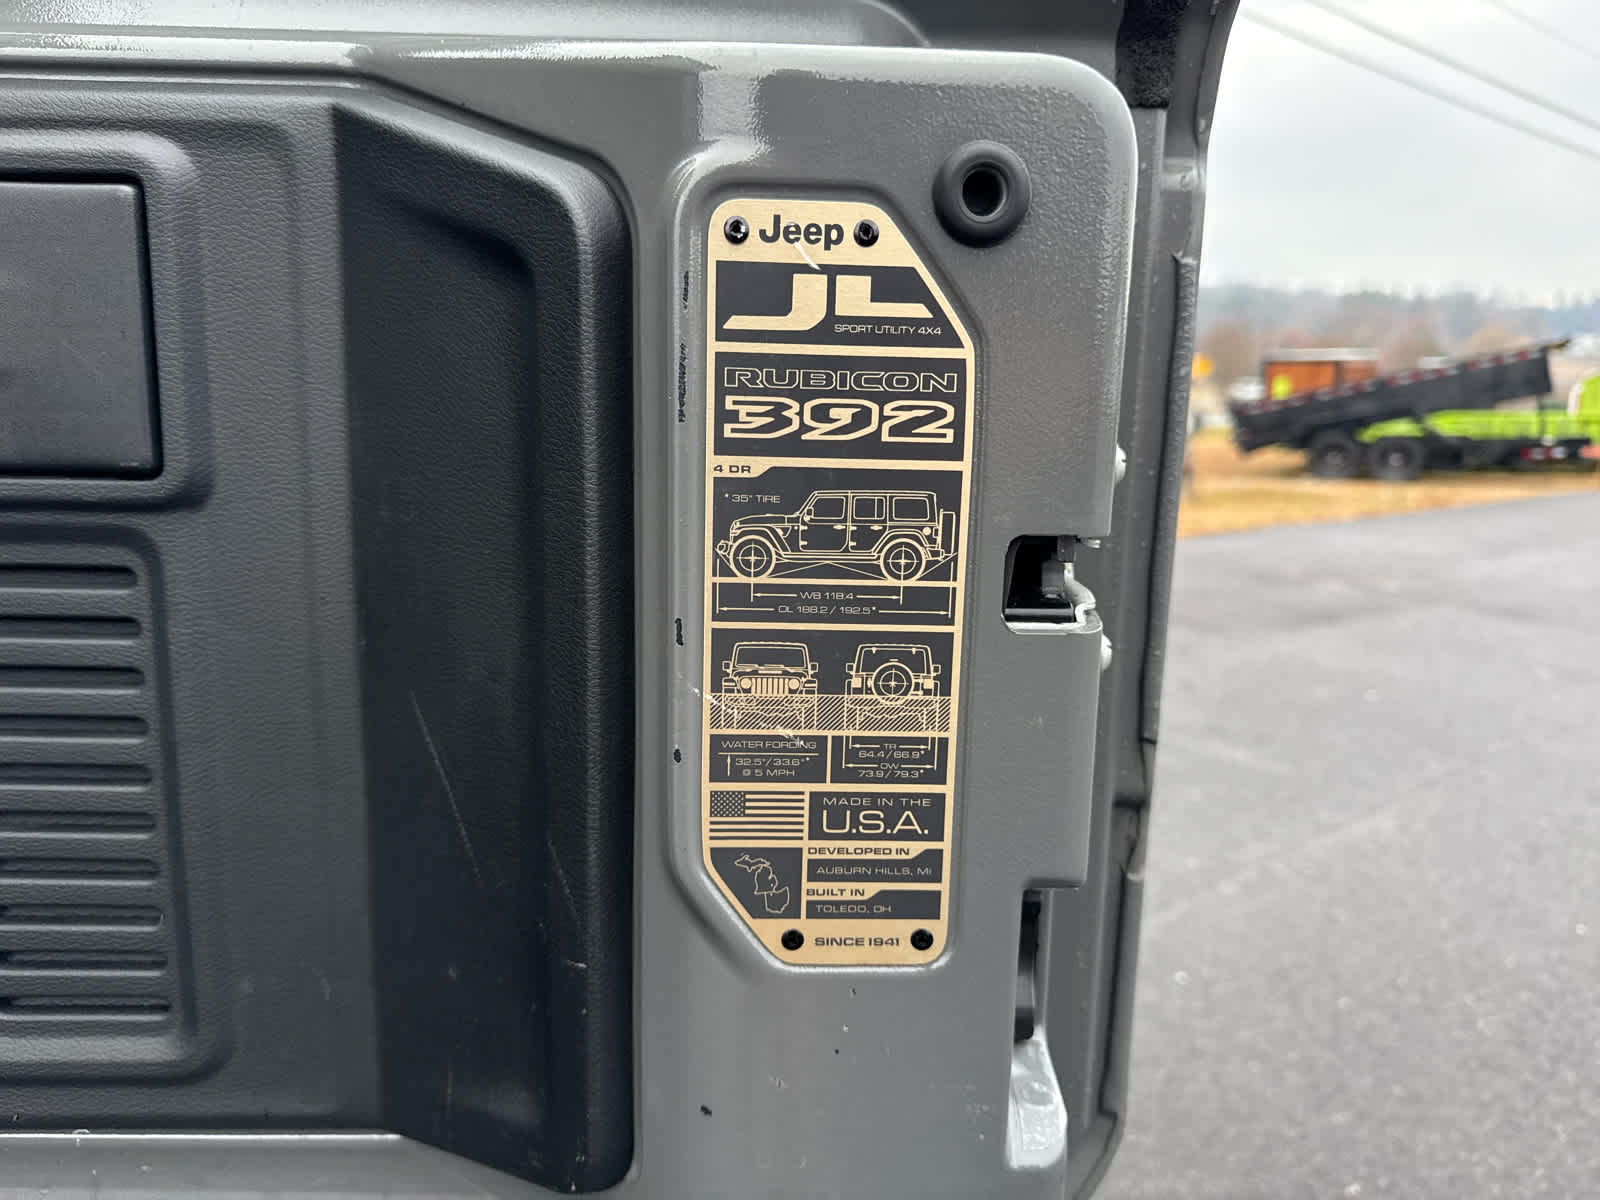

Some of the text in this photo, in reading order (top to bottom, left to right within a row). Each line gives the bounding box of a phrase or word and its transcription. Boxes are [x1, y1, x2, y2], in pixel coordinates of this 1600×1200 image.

[758, 214, 844, 251] Jeep
[722, 273, 934, 331] JL
[834, 323, 873, 334] SPORT
[875, 324, 915, 335] UTILITY
[724, 367, 958, 392] RUBICON
[723, 395, 955, 443] 392
[713, 465, 751, 473] 4 DR
[755, 495, 781, 504] TIRE
[800, 592, 854, 600] WB 118.4
[721, 740, 817, 749] WATER FORDING
[766, 769, 795, 777] MPH
[823, 797, 932, 808] MADE IN THE
[822, 810, 929, 835] U.S.A.
[808, 847, 910, 856] DEVELOPED IN
[816, 865, 932, 877] AUBURN HILLS, MI
[806, 888, 865, 897] BUILT IN
[815, 904, 892, 914] TOLEDO, OH
[814, 936, 900, 947] SINCE 1941
